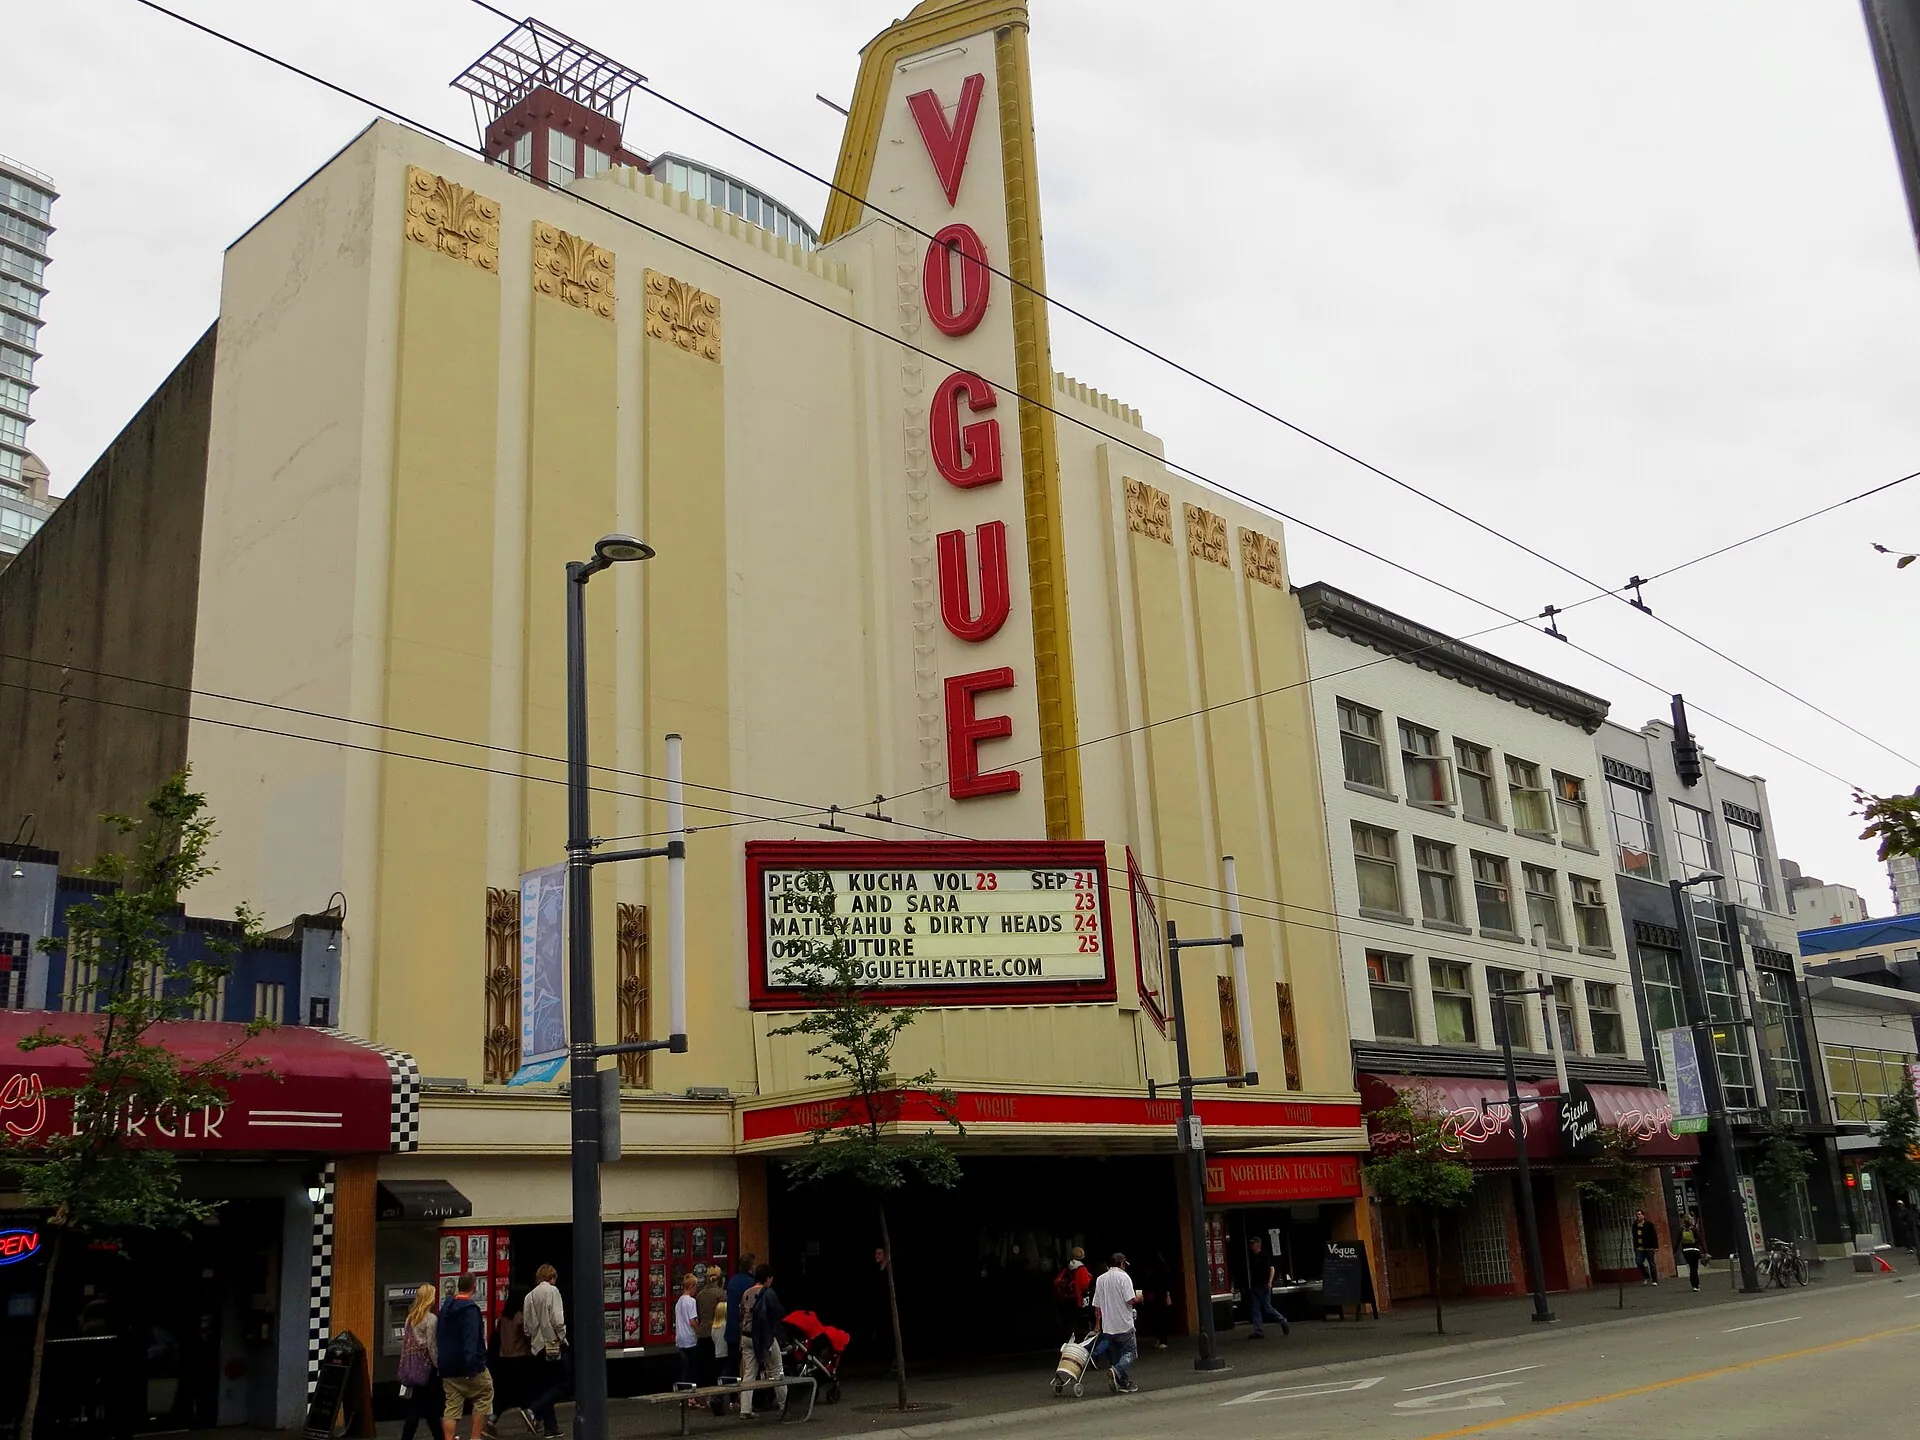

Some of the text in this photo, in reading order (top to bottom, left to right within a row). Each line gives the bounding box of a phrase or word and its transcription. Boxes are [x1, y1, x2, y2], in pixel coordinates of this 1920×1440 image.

[906, 73, 1020, 800] VOGUE
[768, 871, 1094, 893] PECA KUCHA VOL 23 SEP 21
[852, 894, 892, 913] AND
[906, 894, 960, 913] SARA
[1074, 892, 1096, 911] 23
[903, 916, 916, 935] &
[930, 915, 989, 935] DIRTY
[1001, 913, 1062, 934] HEADS
[1074, 913, 1097, 932] 24
[833, 937, 914, 957] UTURE
[1078, 934, 1099, 953] 25
[845, 957, 1042, 980] OGUETHEATRE.COM
[792, 1102, 837, 1128] VOGUE
[974, 1096, 1019, 1119] VOGUE
[1144, 1101, 1180, 1121] VOGUE
[1284, 1105, 1314, 1124] VOGUE
[1207, 1169, 1223, 1188] NT
[1230, 1162, 1335, 1182] NORTHERN TICKETS
[1327, 1243, 1356, 1258] Vogue
